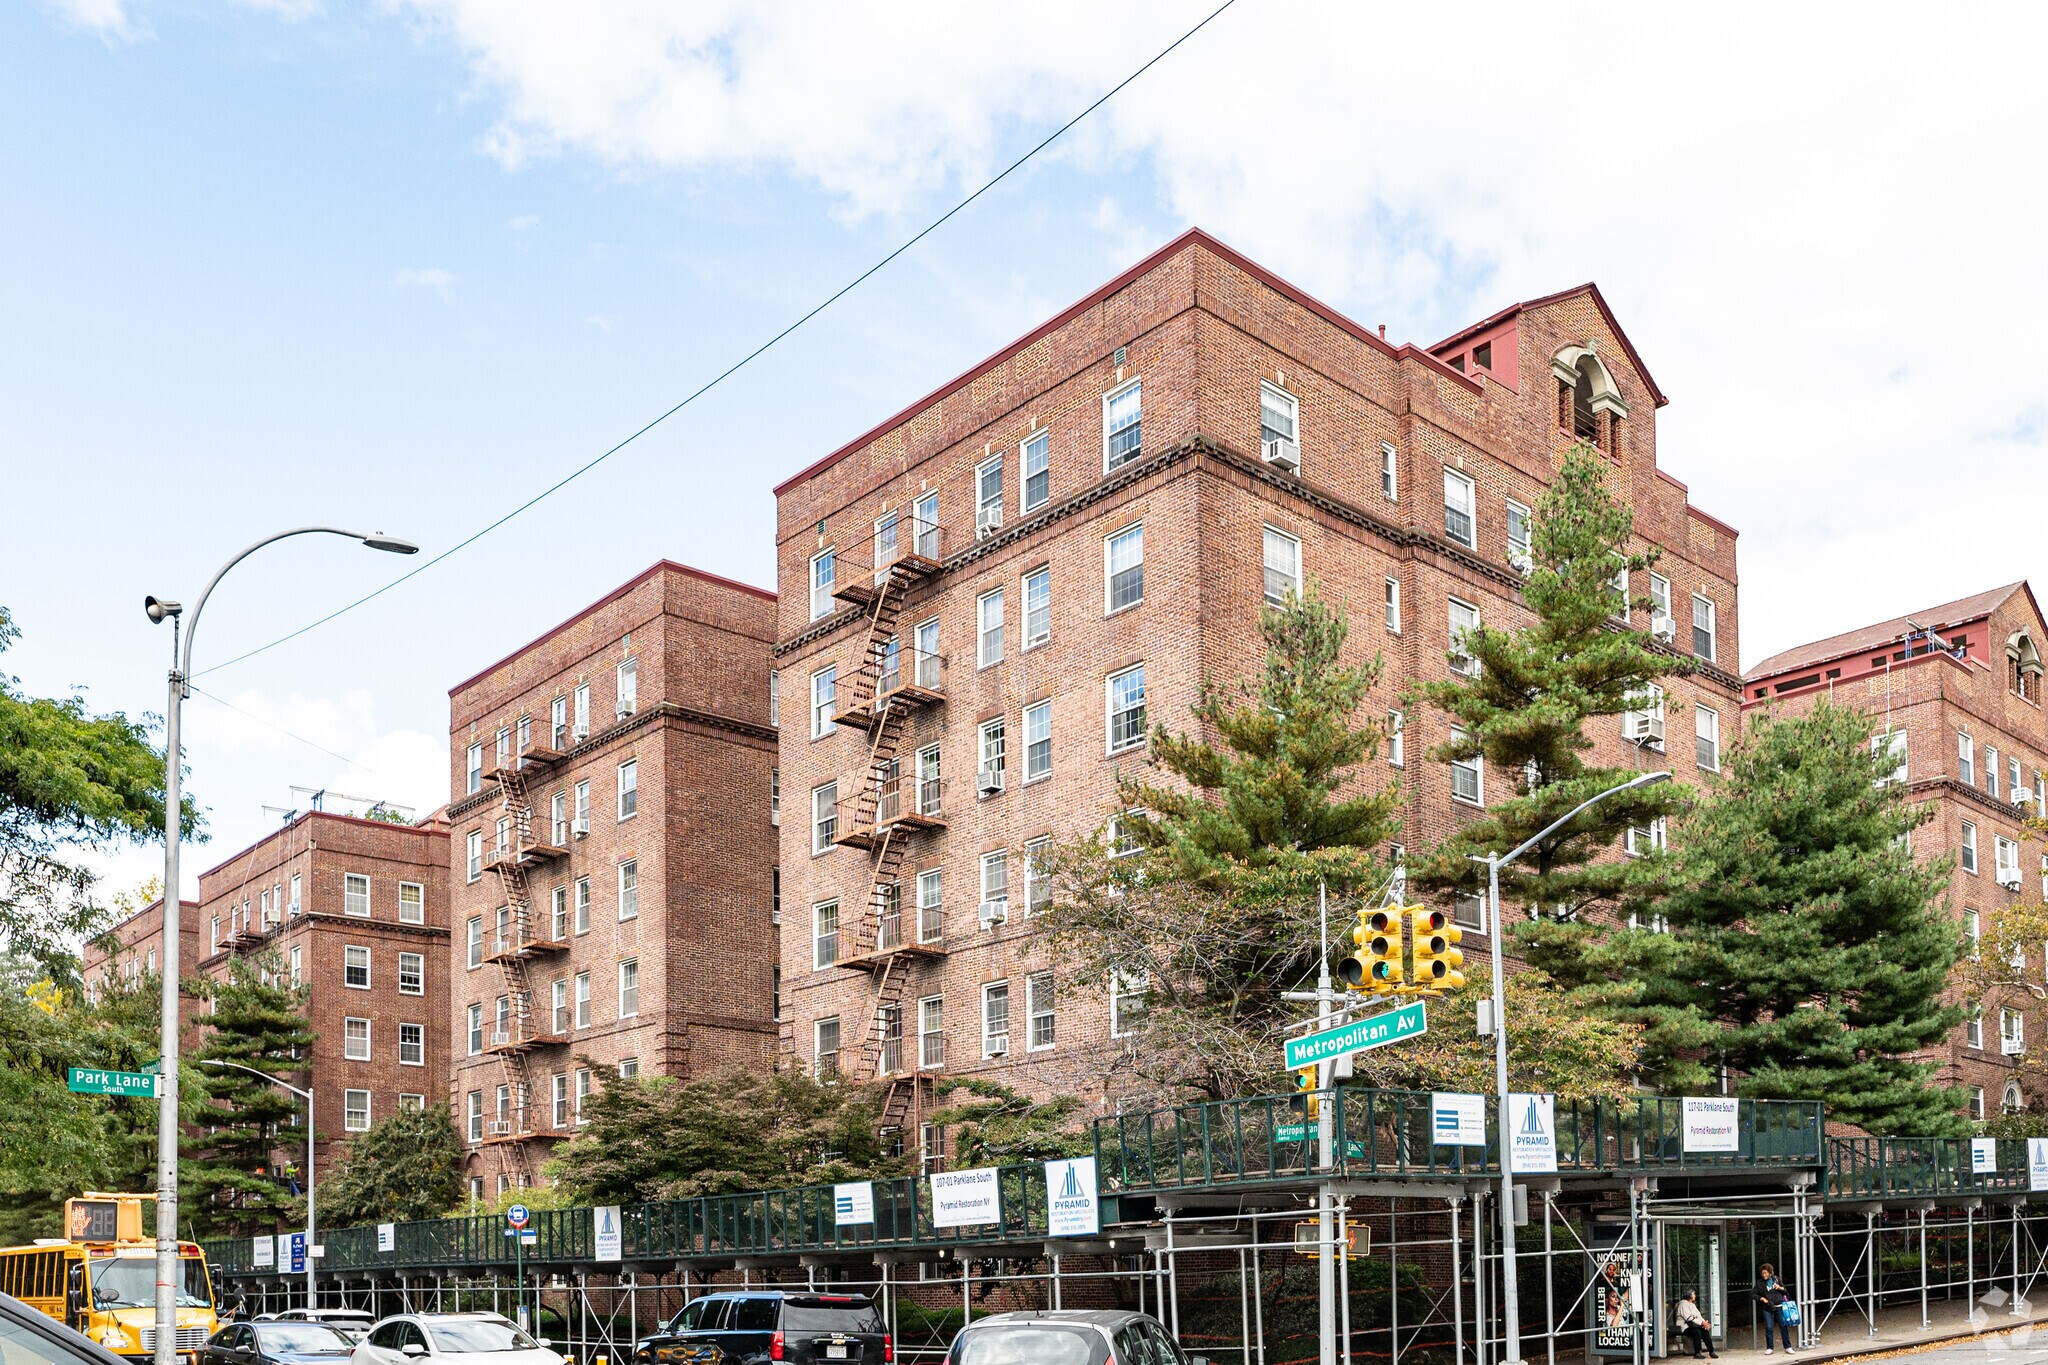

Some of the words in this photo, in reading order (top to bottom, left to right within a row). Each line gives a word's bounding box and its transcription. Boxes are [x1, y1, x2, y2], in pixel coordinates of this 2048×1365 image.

[1294, 1024, 1388, 1061] Metropolitan
[1396, 1015, 1416, 1033] Av
[76, 1070, 109, 1085] Park
[116, 1073, 150, 1088] Lane
[102, 1085, 124, 1093] South
[1703, 1101, 1722, 1112] Parklane
[1722, 1102, 1735, 1112] South
[1690, 1126, 1706, 1136] Pyramid
[1706, 1126, 1726, 1135] Restoration
[1516, 1136, 1549, 1146] PYRAMID
[953, 1174, 976, 1186] Parklane
[976, 1171, 993, 1183] South
[940, 1200, 958, 1211] Pyramid
[958, 1198, 983, 1209] Restoration
[983, 1197, 991, 1206] NY
[1054, 1199, 1090, 1210] PYRAMID
[1610, 1252, 1628, 1262] ONE
[1620, 1268, 1652, 1278] KNWS
[1597, 1286, 1606, 1322] BETTER
[1607, 1327, 1630, 1337] THAN
[1598, 1336, 1630, 1347] LOCALS
